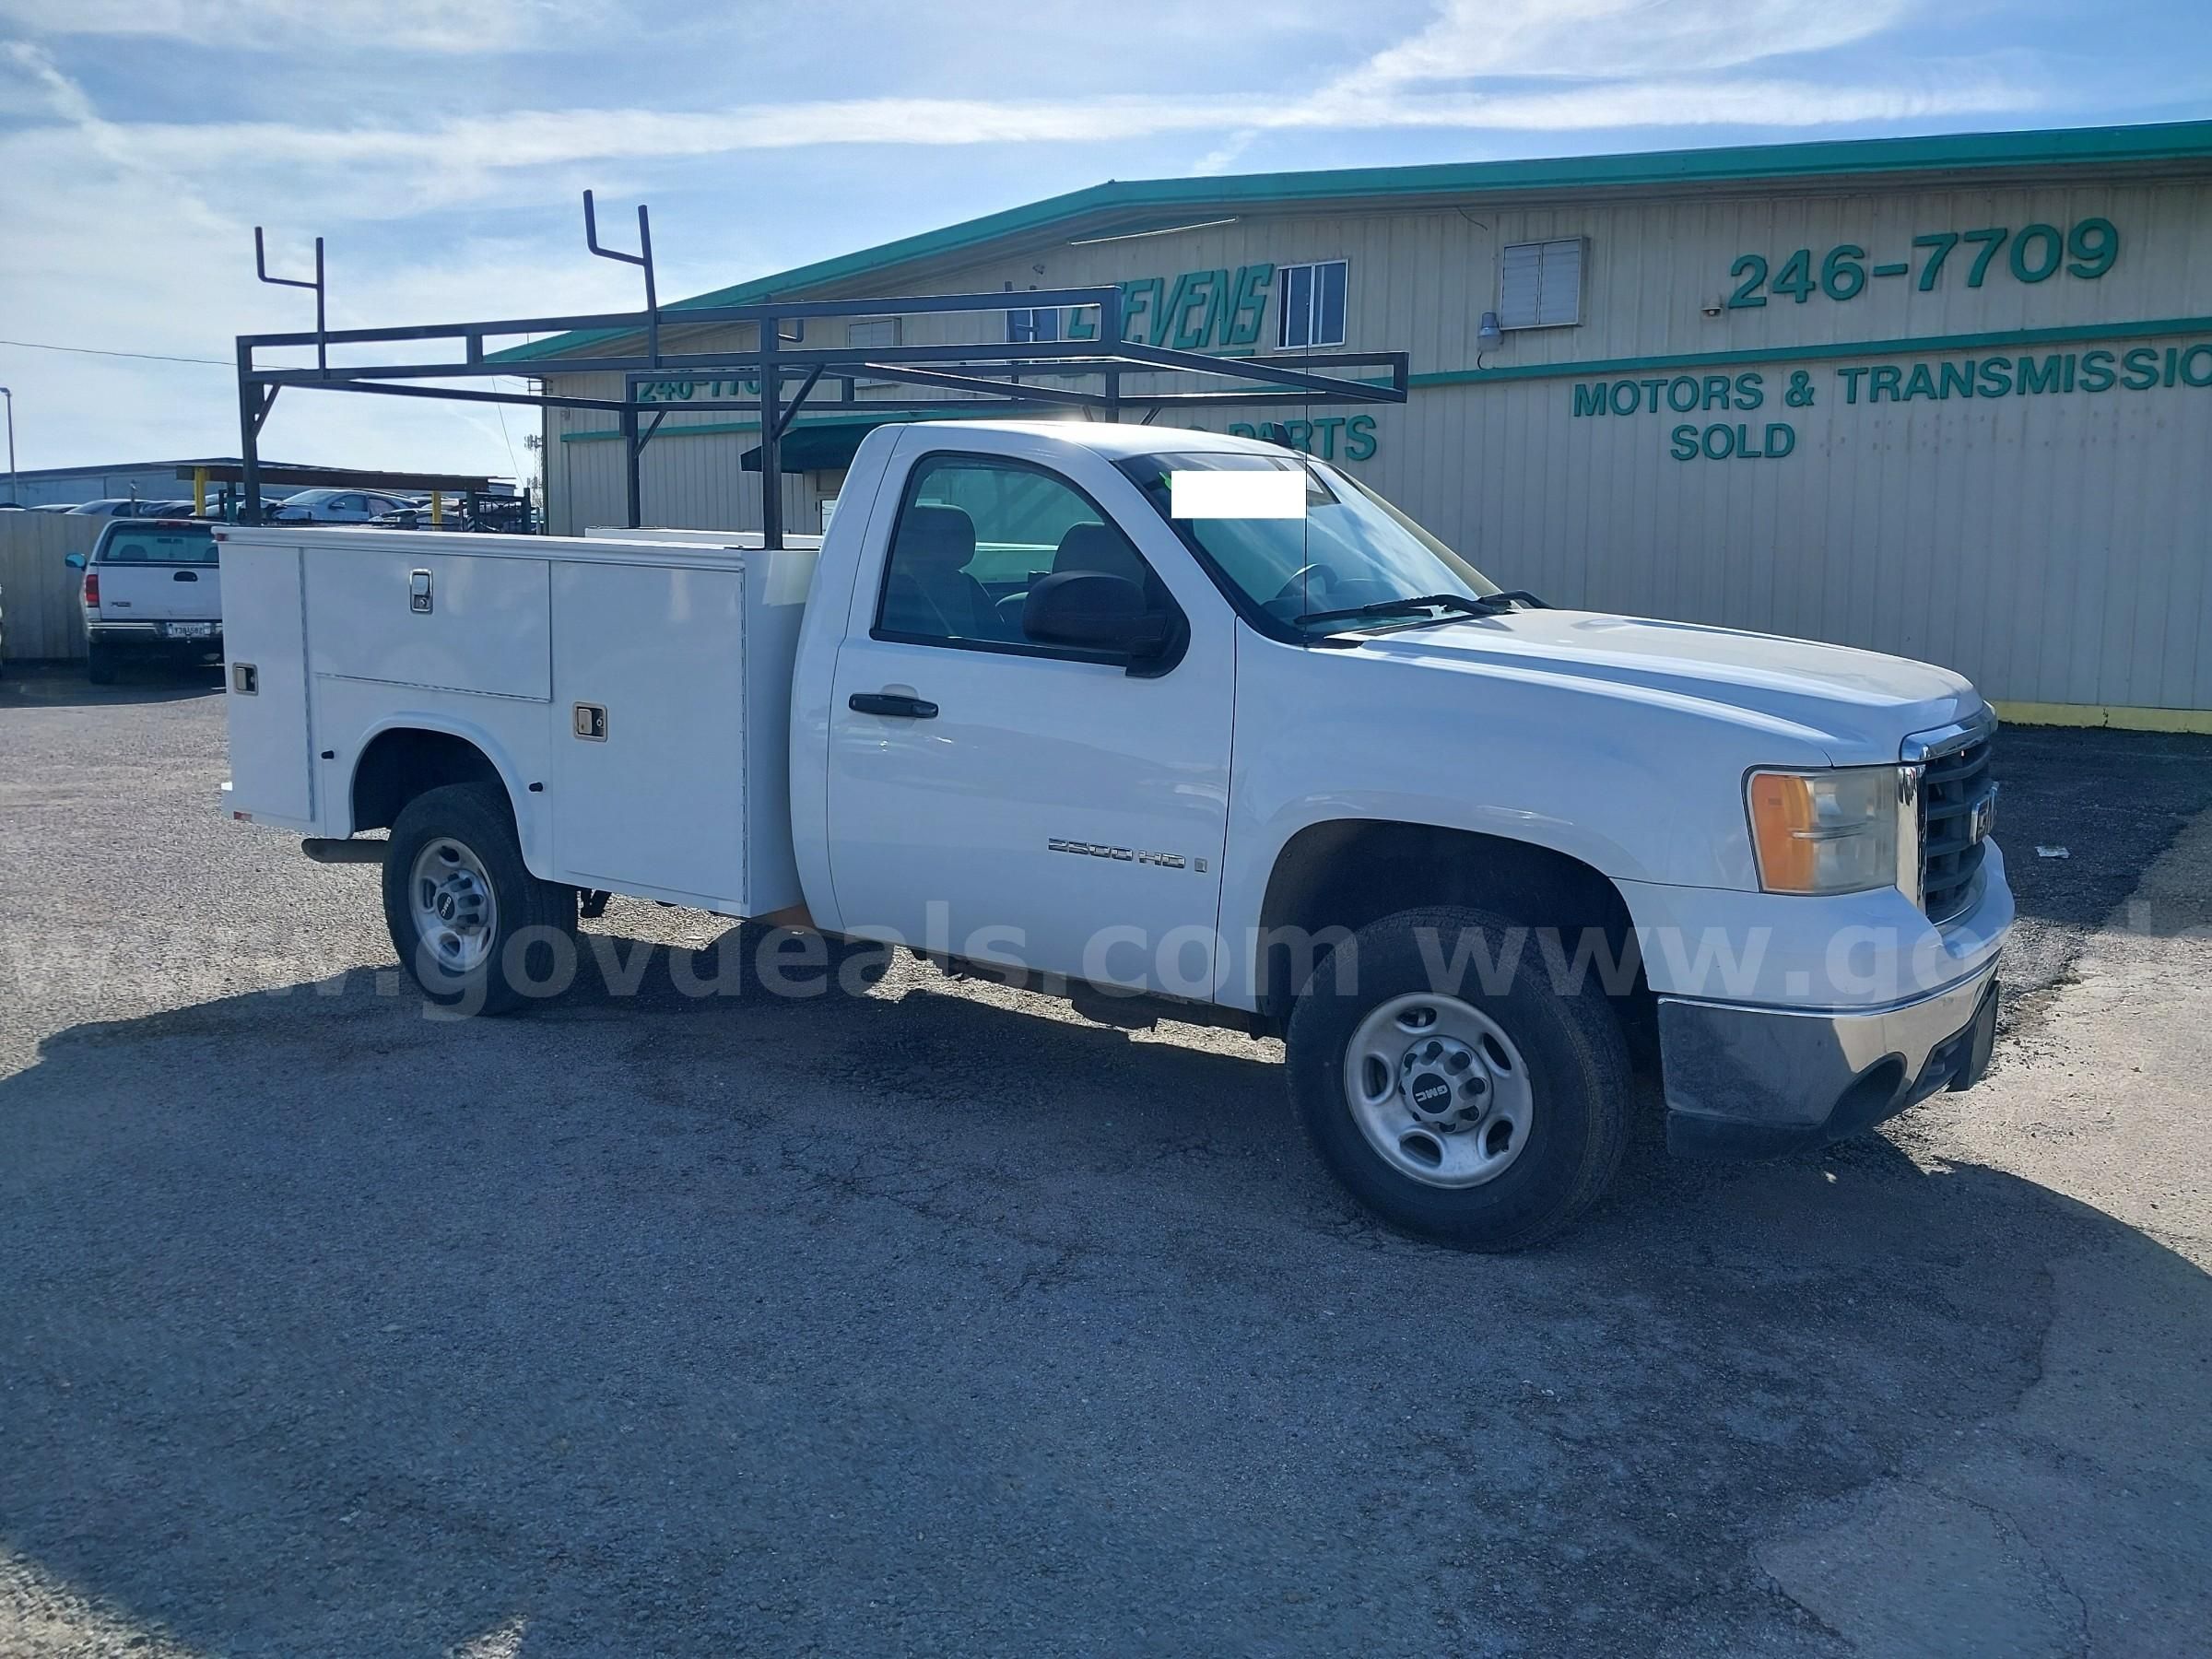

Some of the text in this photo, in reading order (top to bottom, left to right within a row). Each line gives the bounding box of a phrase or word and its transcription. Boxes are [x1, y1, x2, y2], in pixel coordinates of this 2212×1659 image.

[1728, 218, 2119, 309] 246-7709
[1066, 263, 1275, 352] EVENS
[1573, 372, 1764, 418] MOTORS
[1784, 371, 1815, 406] &
[1669, 422, 1795, 461] SOLD
[1048, 838, 1186, 869] 2500 HD
[1415, 1084, 1448, 1102] GMC
